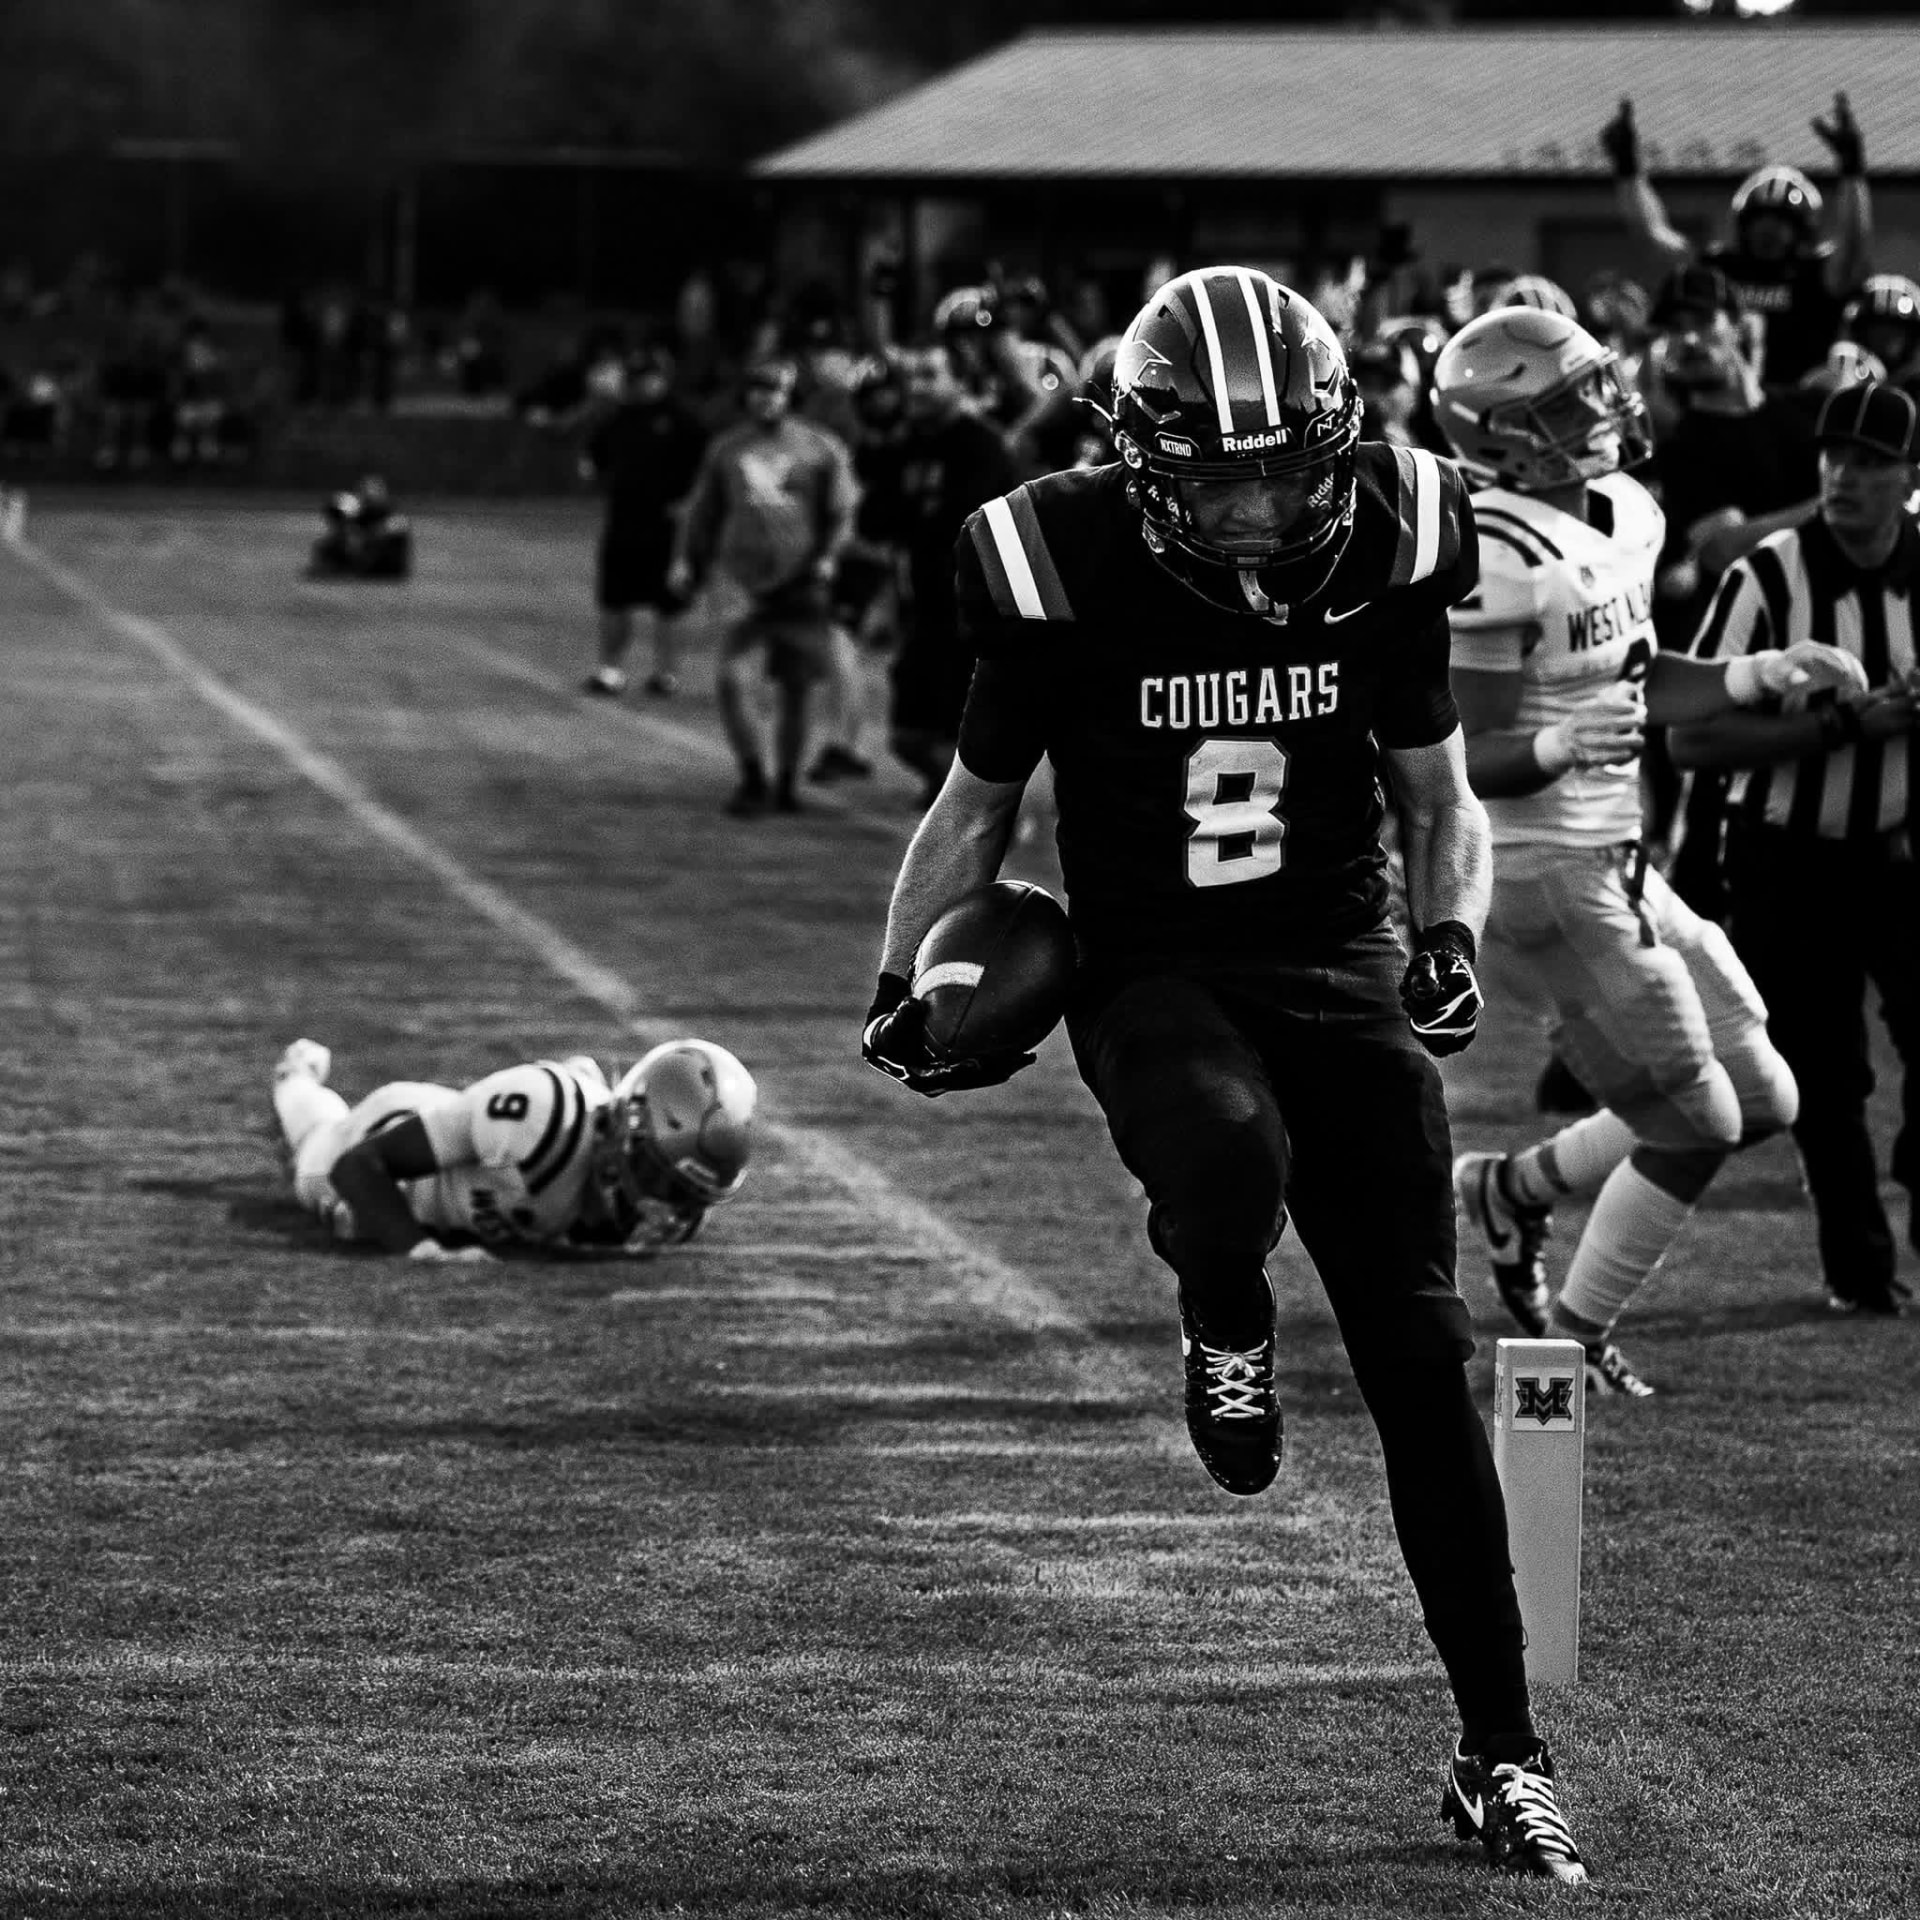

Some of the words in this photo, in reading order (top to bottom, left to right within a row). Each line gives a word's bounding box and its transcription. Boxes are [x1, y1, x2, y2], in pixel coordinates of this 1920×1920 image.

[1159, 438, 1192, 457] NXTRND
[1222, 428, 1288, 452] Riddell
[1567, 596, 1623, 653] WEST
[1141, 662, 1339, 729] COUGARS
[1183, 738, 1288, 888] 8
